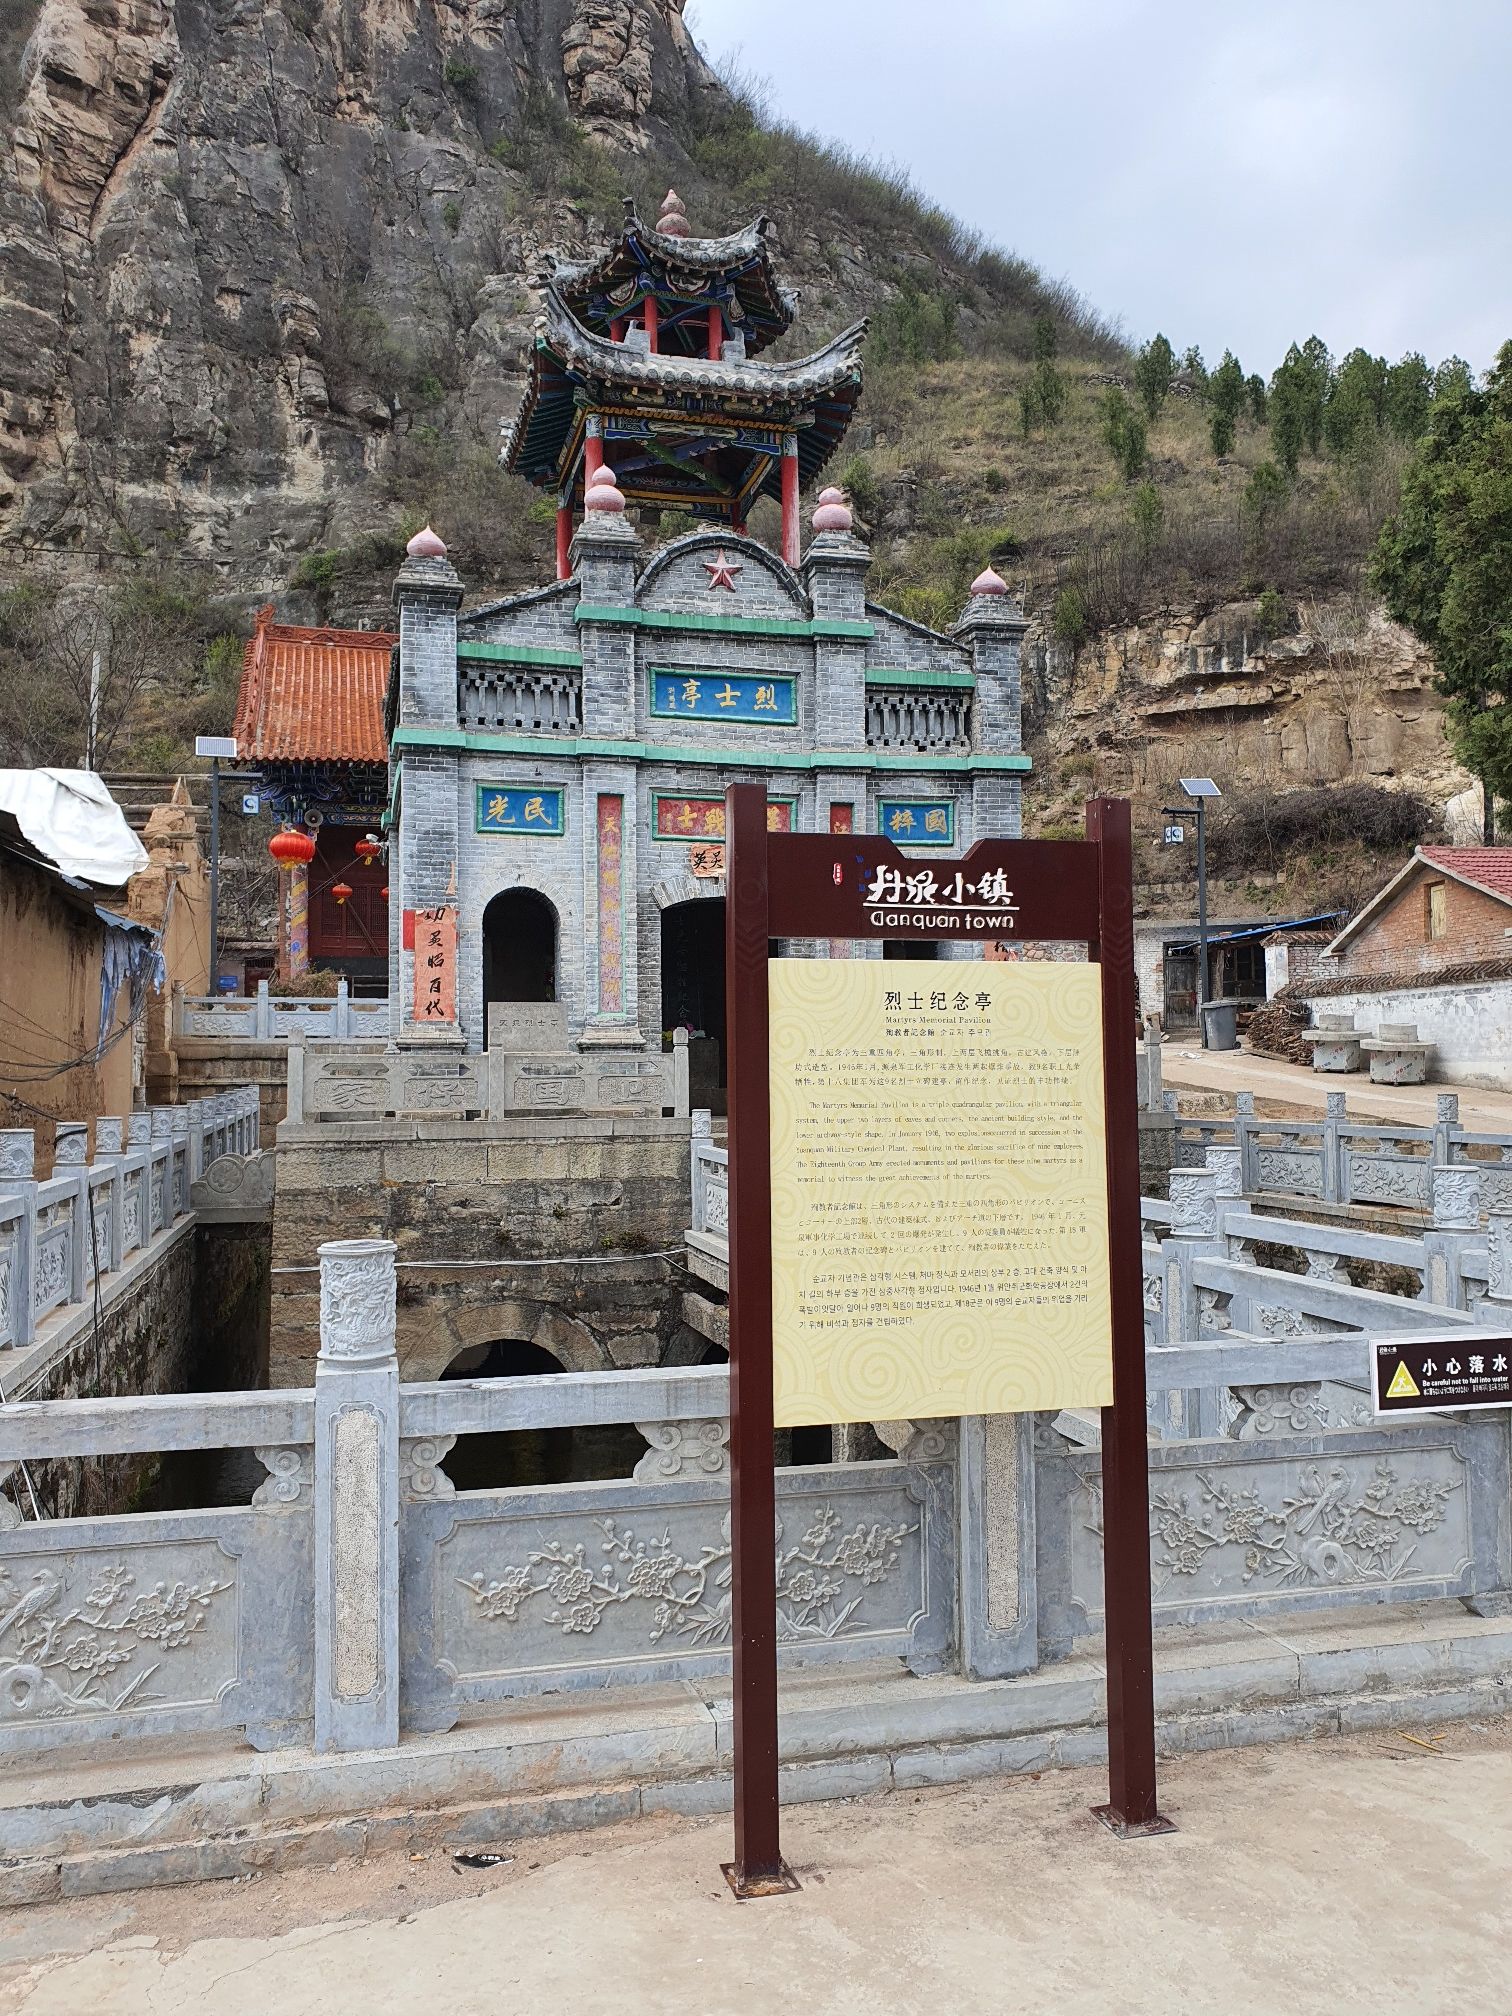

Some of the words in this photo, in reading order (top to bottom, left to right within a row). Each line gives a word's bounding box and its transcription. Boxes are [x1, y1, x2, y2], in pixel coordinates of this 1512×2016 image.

[964, 913, 1014, 930] town
[883, 991, 991, 1011] 烈士纪念亭
[885, 1016, 917, 1025] Martyrs
[919, 1016, 957, 1024] Memorial
[959, 1016, 992, 1024] Pavilion
[822, 1102, 848, 1110] Martyrs
[850, 1101, 878, 1109] Memorial
[880, 1100, 909, 1108] Pavilion
[928, 1100, 949, 1109] triple
[951, 1100, 992, 1109] quadrangular
[1050, 1100, 1082, 1108] triangular
[823, 1116, 834, 1124] the
[872, 1116, 892, 1124] layers
[1007, 1114, 1035, 1122] building
[898, 1130, 922, 1138] January
[1072, 1128, 1083, 1136] the
[826, 1145, 854, 1154] Military
[857, 1144, 885, 1152] Chemical
[912, 1144, 942, 1152] resulting
[967, 1144, 994, 1152] glorious
[796, 1160, 808, 1168] The
[810, 1160, 846, 1168] Eighteenth
[848, 1160, 866, 1168] Group
[868, 1160, 882, 1168] Army
[886, 1159, 910, 1167] erected
[946, 1158, 958, 1166] and
[960, 1158, 992, 1166] pavilions
[838, 1174, 862, 1182] witness
[865, 1174, 876, 1182] the
[878, 1174, 896, 1182] great
[812, 1274, 835, 1284] 순교자
[837, 1272, 868, 1282] 기념관은
[869, 1272, 892, 1282] 삼각형
[919, 1270, 934, 1280] 처마
[960, 1268, 988, 1278] 모서리의
[990, 1268, 1005, 1278] 상부
[1006, 1268, 1011, 1276] 2
[1024, 1266, 1036, 1276] 고대
[1039, 1266, 1053, 1276] 건축
[1056, 1266, 1068, 1275] 양식
[1071, 1265, 1078, 1274] 및
[808, 1289, 824, 1299] 길의
[826, 1288, 841, 1298] 하부
[861, 1287, 876, 1297] 가진
[958, 1284, 981, 1293] 1946년
[846, 1302, 868, 1313] 일어나
[870, 1302, 890, 1312] 9명의
[892, 1301, 914, 1310] 직원이
[986, 1298, 993, 1307] 이
[1014, 1296, 1050, 1306] 순교자들의
[1074, 1294, 1088, 1303] 기리
[808, 1320, 824, 1330] 위해
[826, 1318, 849, 1328] 비석과
[1422, 1353, 1508, 1377] 小心落水
[1422, 1379, 1430, 1387] Be
[1431, 1378, 1450, 1386] careful
